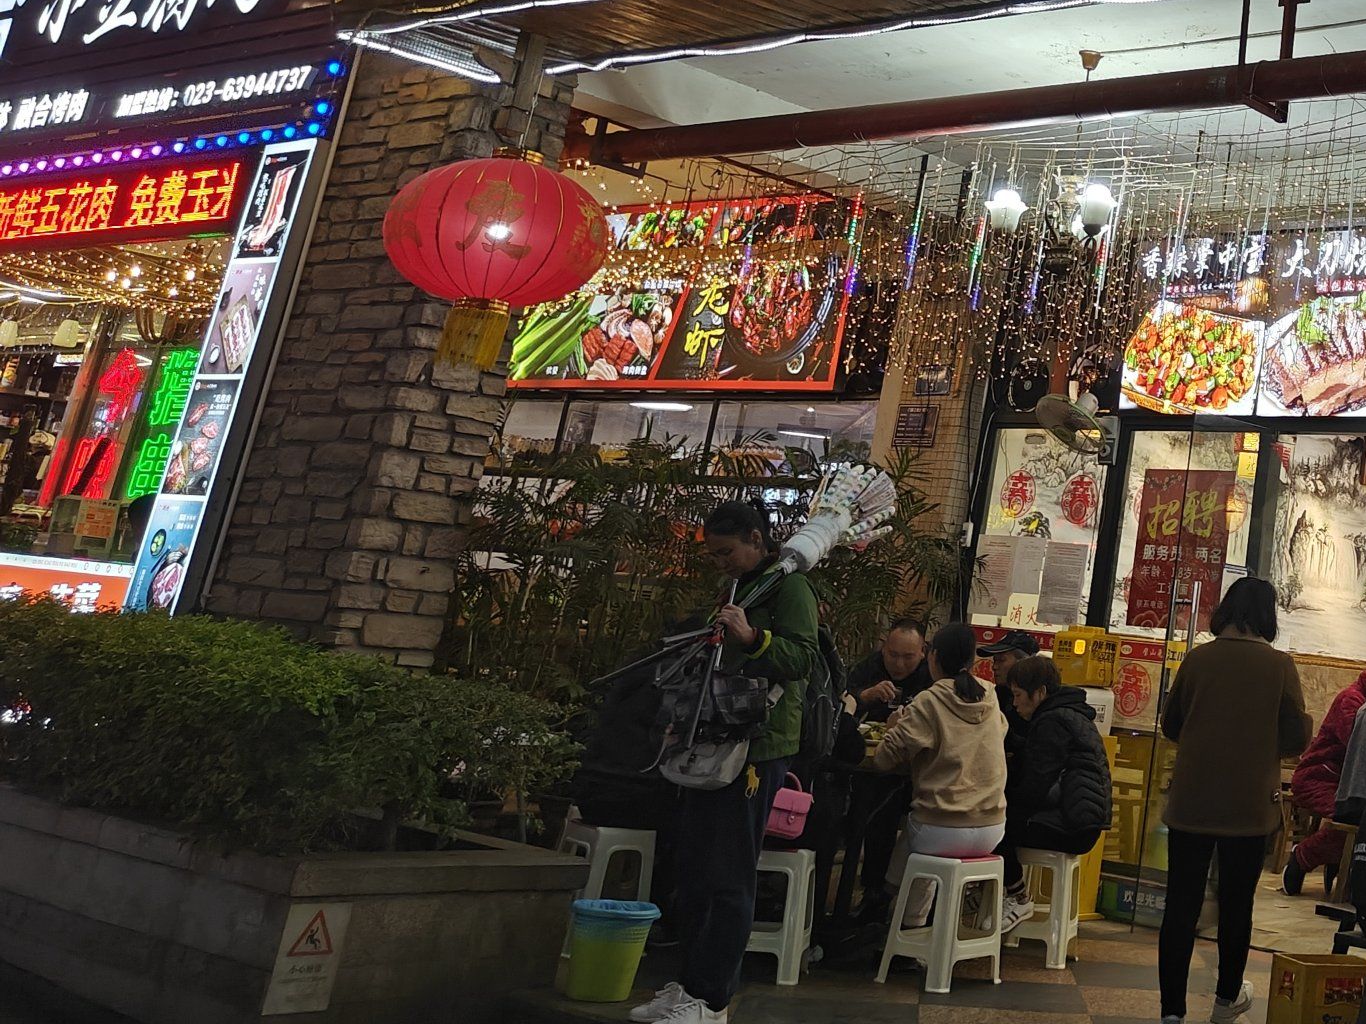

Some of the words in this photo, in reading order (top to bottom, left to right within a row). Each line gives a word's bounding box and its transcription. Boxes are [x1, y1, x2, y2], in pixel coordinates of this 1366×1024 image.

[684, 275, 730, 368] 龙虾
[1147, 489, 1226, 539] 招聘
[1142, 544, 1182, 562] 服务员
[1196, 547, 1222, 563] 两名
[1010, 604, 1053, 627] 消火
